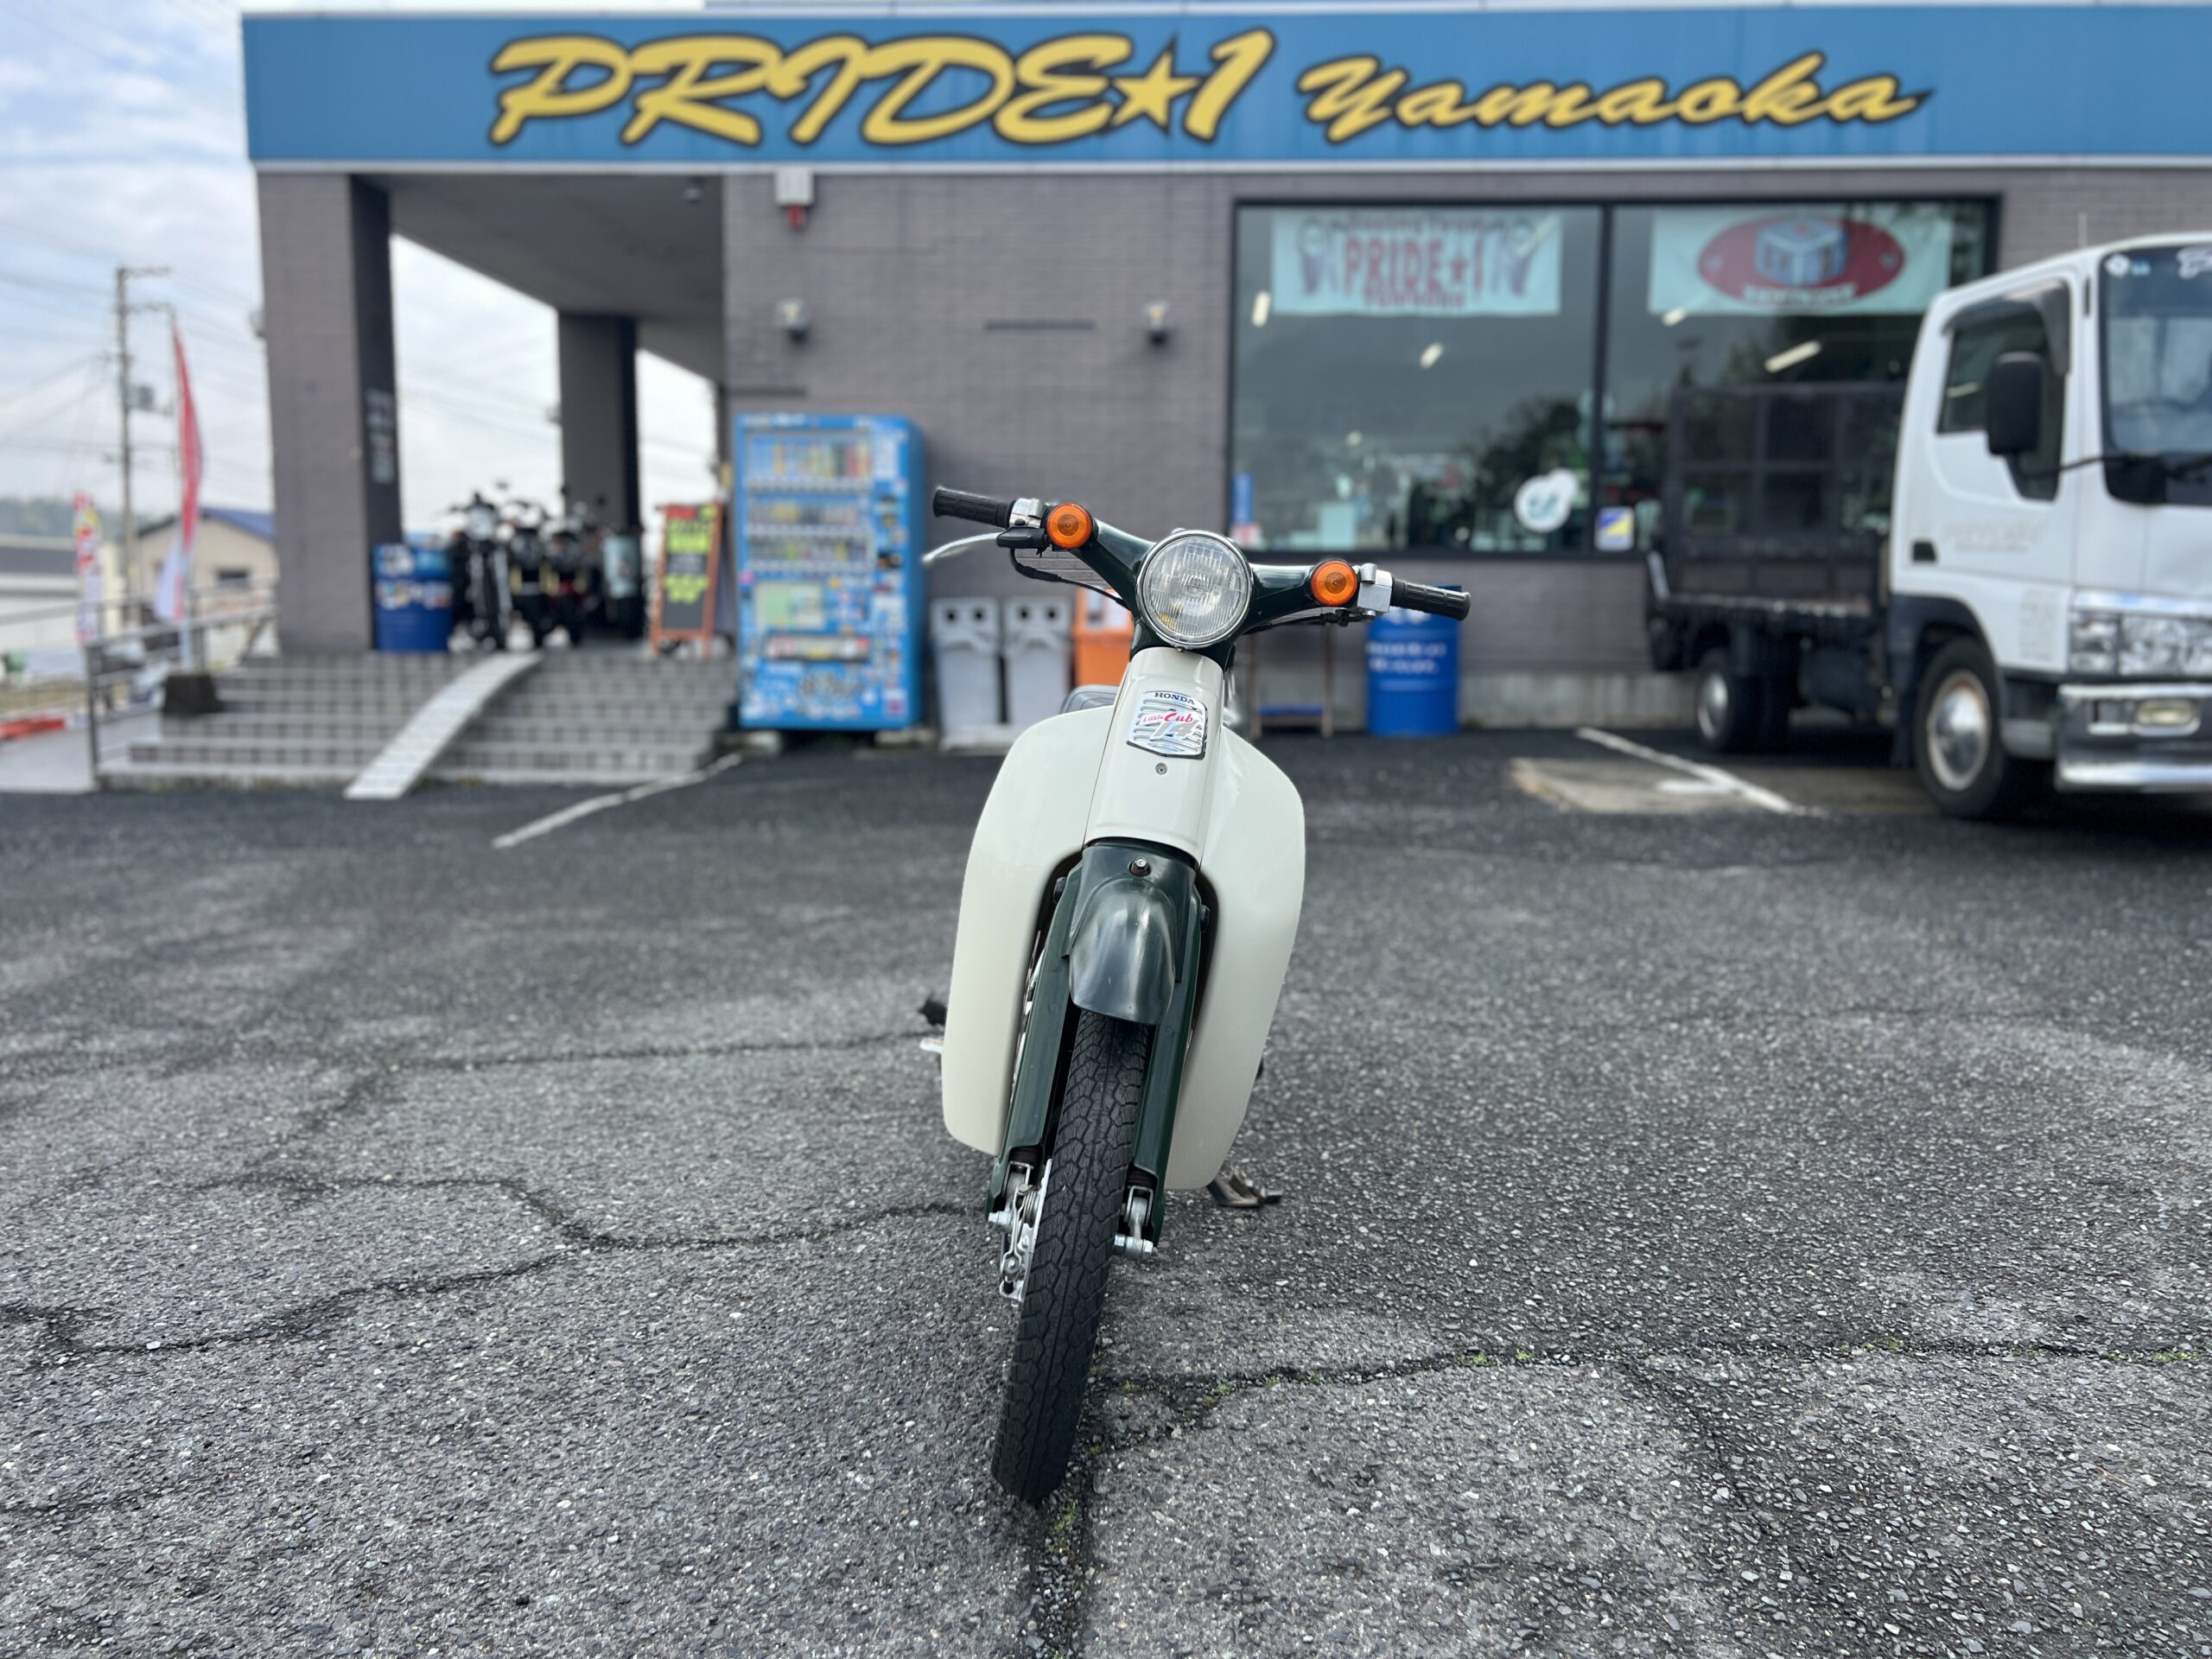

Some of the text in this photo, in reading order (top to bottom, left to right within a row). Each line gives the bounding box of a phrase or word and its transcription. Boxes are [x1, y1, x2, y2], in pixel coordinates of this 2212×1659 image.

[1296, 50, 1932, 145] Yamaoka
[1154, 692, 1195, 704] HONDA
[1164, 712, 1193, 722] Cub
